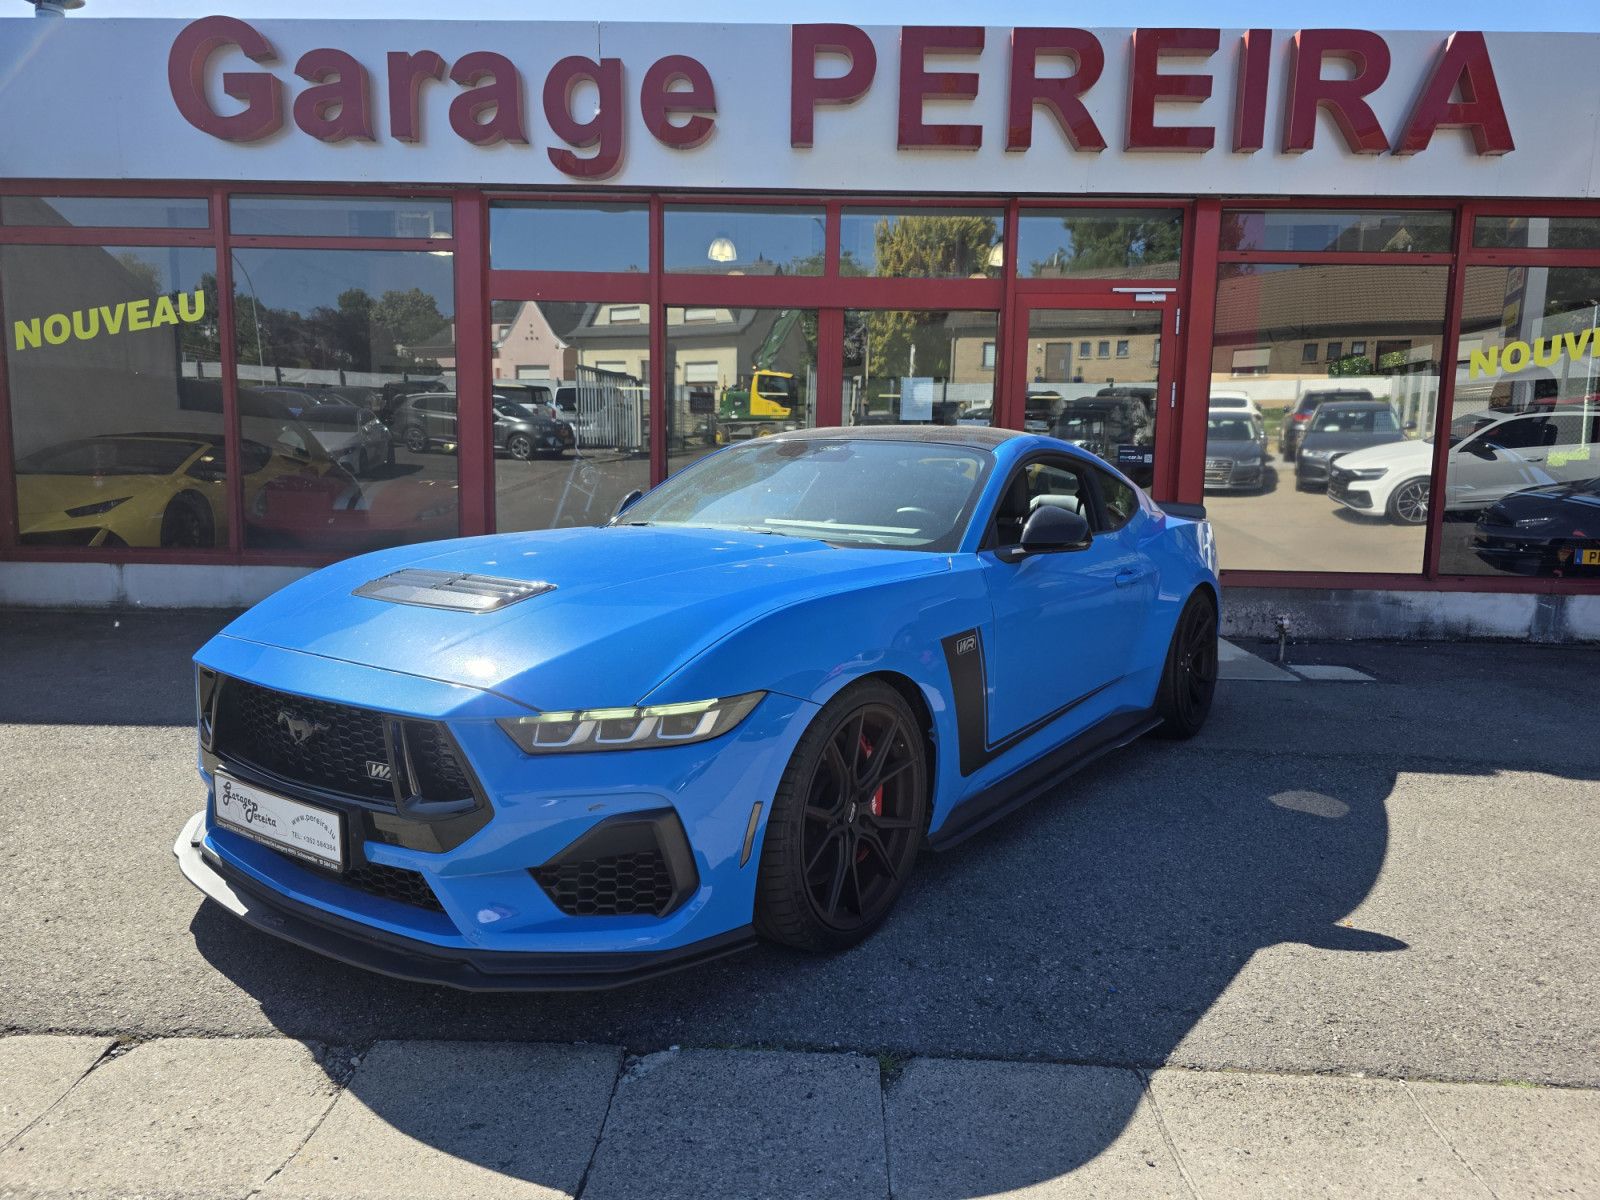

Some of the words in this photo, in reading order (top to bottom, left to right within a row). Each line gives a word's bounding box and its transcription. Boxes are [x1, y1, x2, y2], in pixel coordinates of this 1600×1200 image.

[168, 15, 717, 180] Garage
[790, 23, 1517, 157] PEREIRA
[14, 289, 206, 350] NOUVEAU
[222, 781, 253, 810] Garage
[246, 802, 277, 828] Pereira
[291, 814, 336, 840] www.pereira.lu
